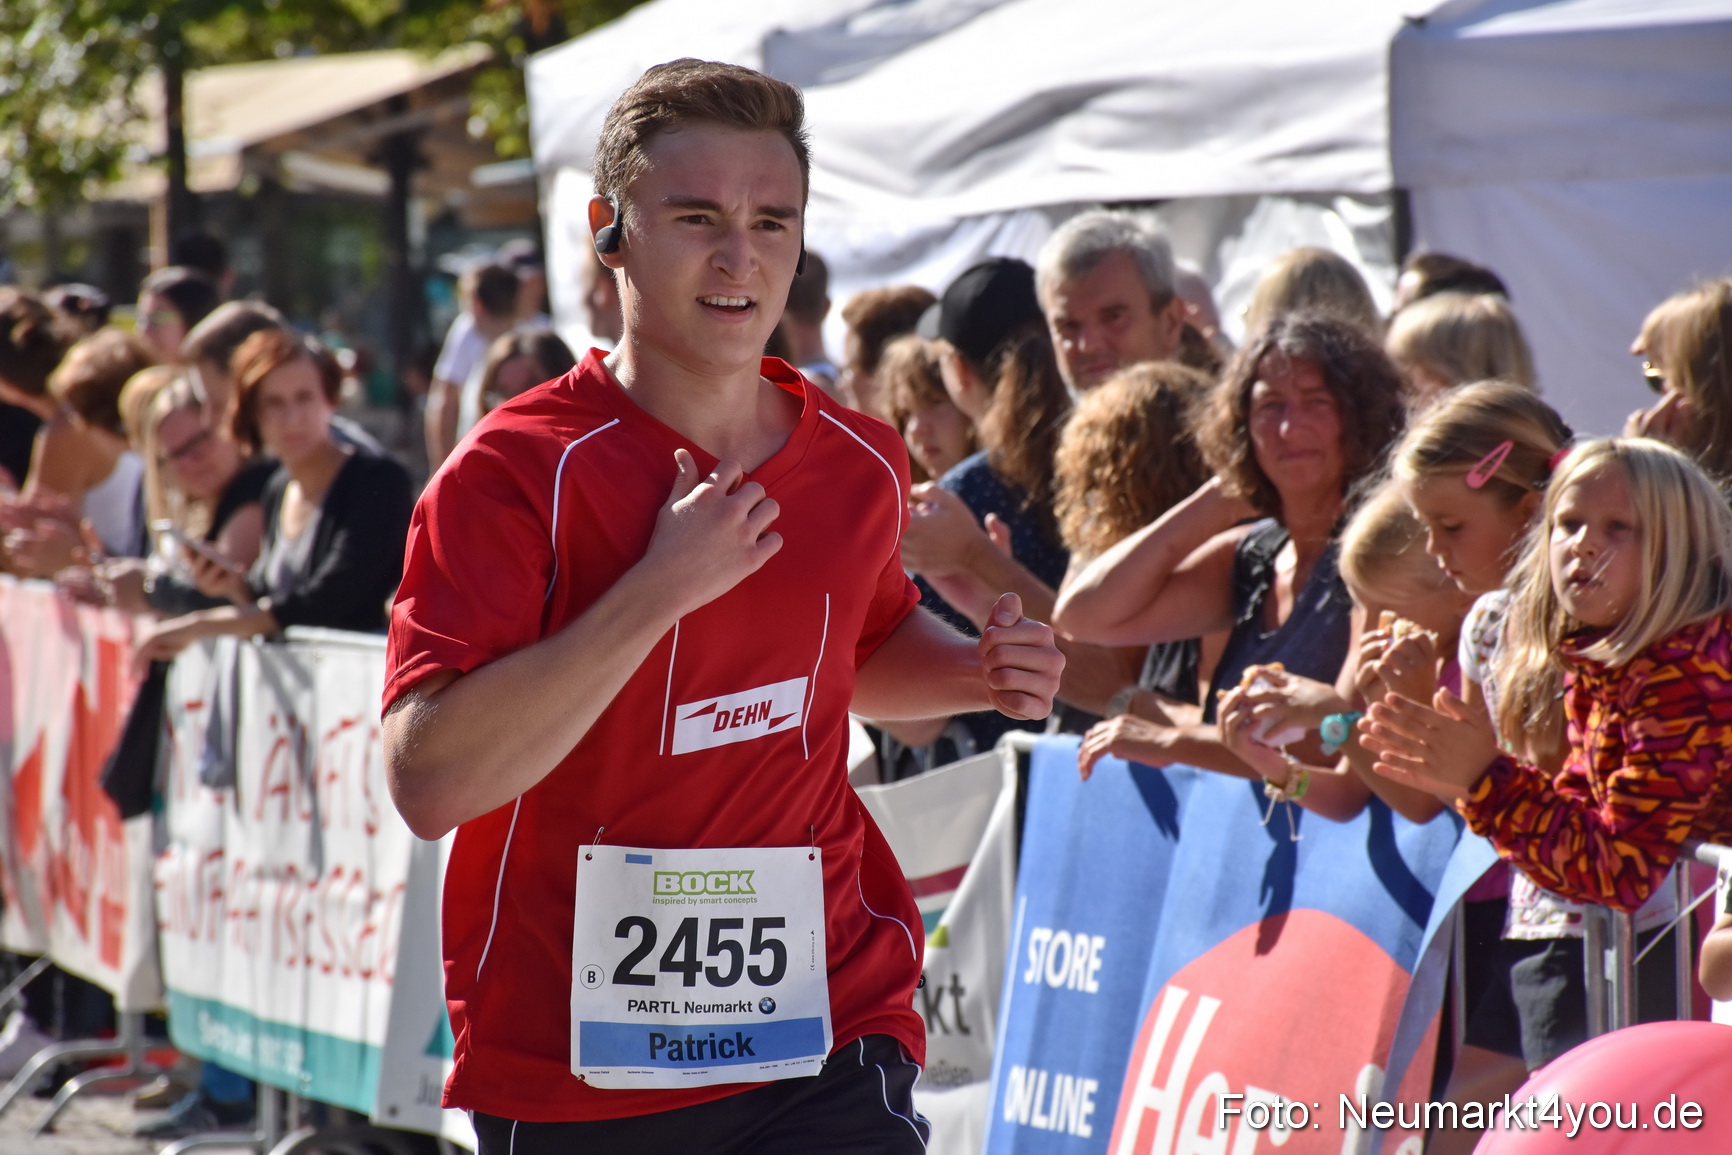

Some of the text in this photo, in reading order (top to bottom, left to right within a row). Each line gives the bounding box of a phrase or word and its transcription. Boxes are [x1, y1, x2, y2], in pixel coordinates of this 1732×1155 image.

[713, 699, 773, 733] DEHN
[653, 870, 756, 895] BOCK
[653, 896, 686, 906] inspired
[688, 897, 698, 905] by
[724, 896, 758, 904] concepts
[612, 915, 788, 988] 2455
[1024, 926, 1105, 994] STORE
[587, 972, 596, 984] B
[627, 1000, 680, 1014] PARTL
[684, 1000, 753, 1014] Neumarkt
[649, 1032, 756, 1061] Patrick
[1003, 1065, 1098, 1138] ONLINE
